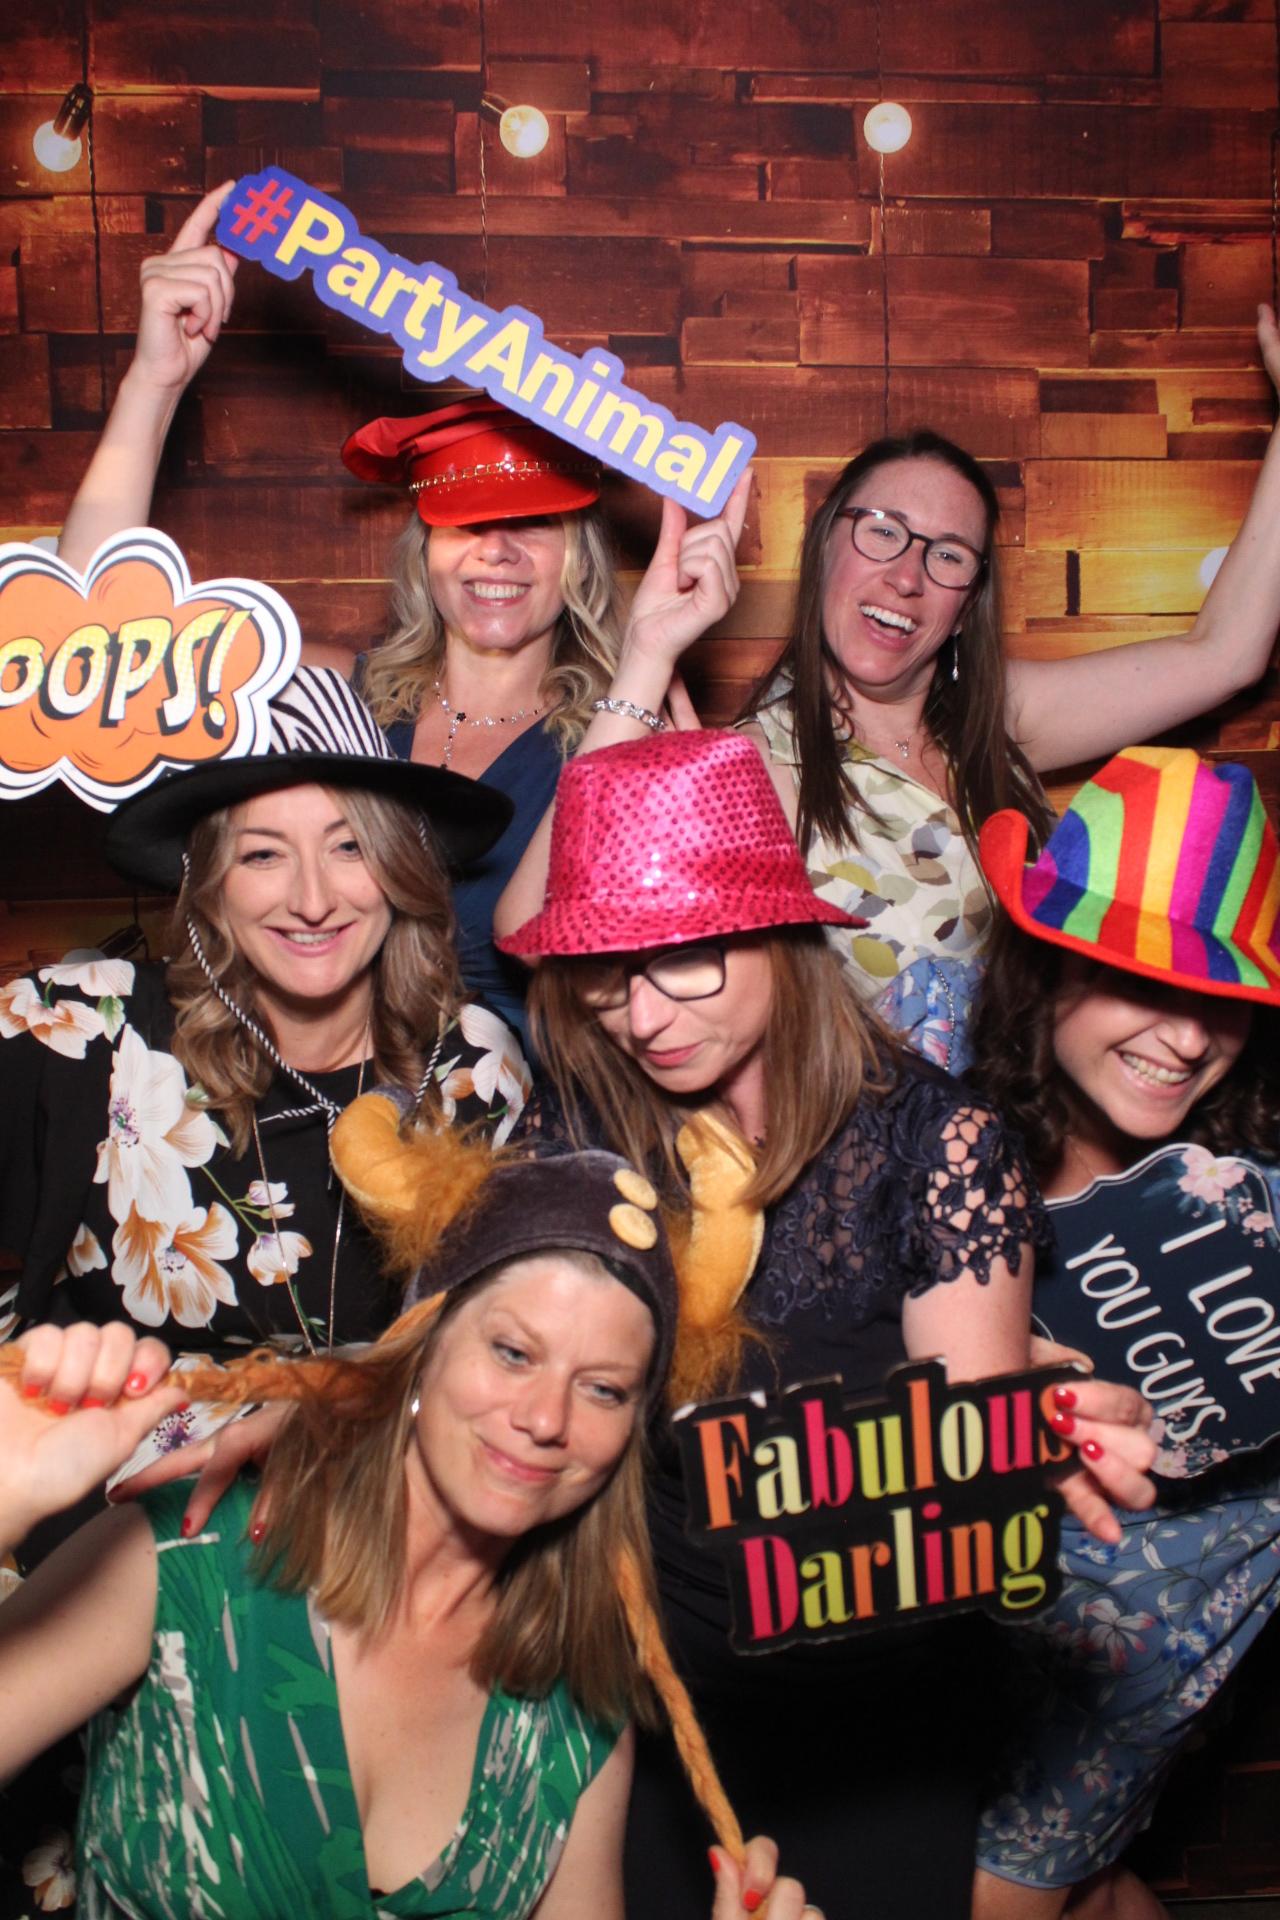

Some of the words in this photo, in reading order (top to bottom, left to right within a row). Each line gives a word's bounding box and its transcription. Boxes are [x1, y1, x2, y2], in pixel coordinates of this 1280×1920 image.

[231, 178, 743, 504] #PartyAnimal
[0, 607, 252, 739] OOPS!
[1160, 1219, 1226, 1254] I
[1065, 1233, 1162, 1330] YOU
[1126, 1331, 1227, 1442] GUYS
[1187, 1265, 1280, 1394] LOVE
[739, 1502, 1049, 1641] Darling
